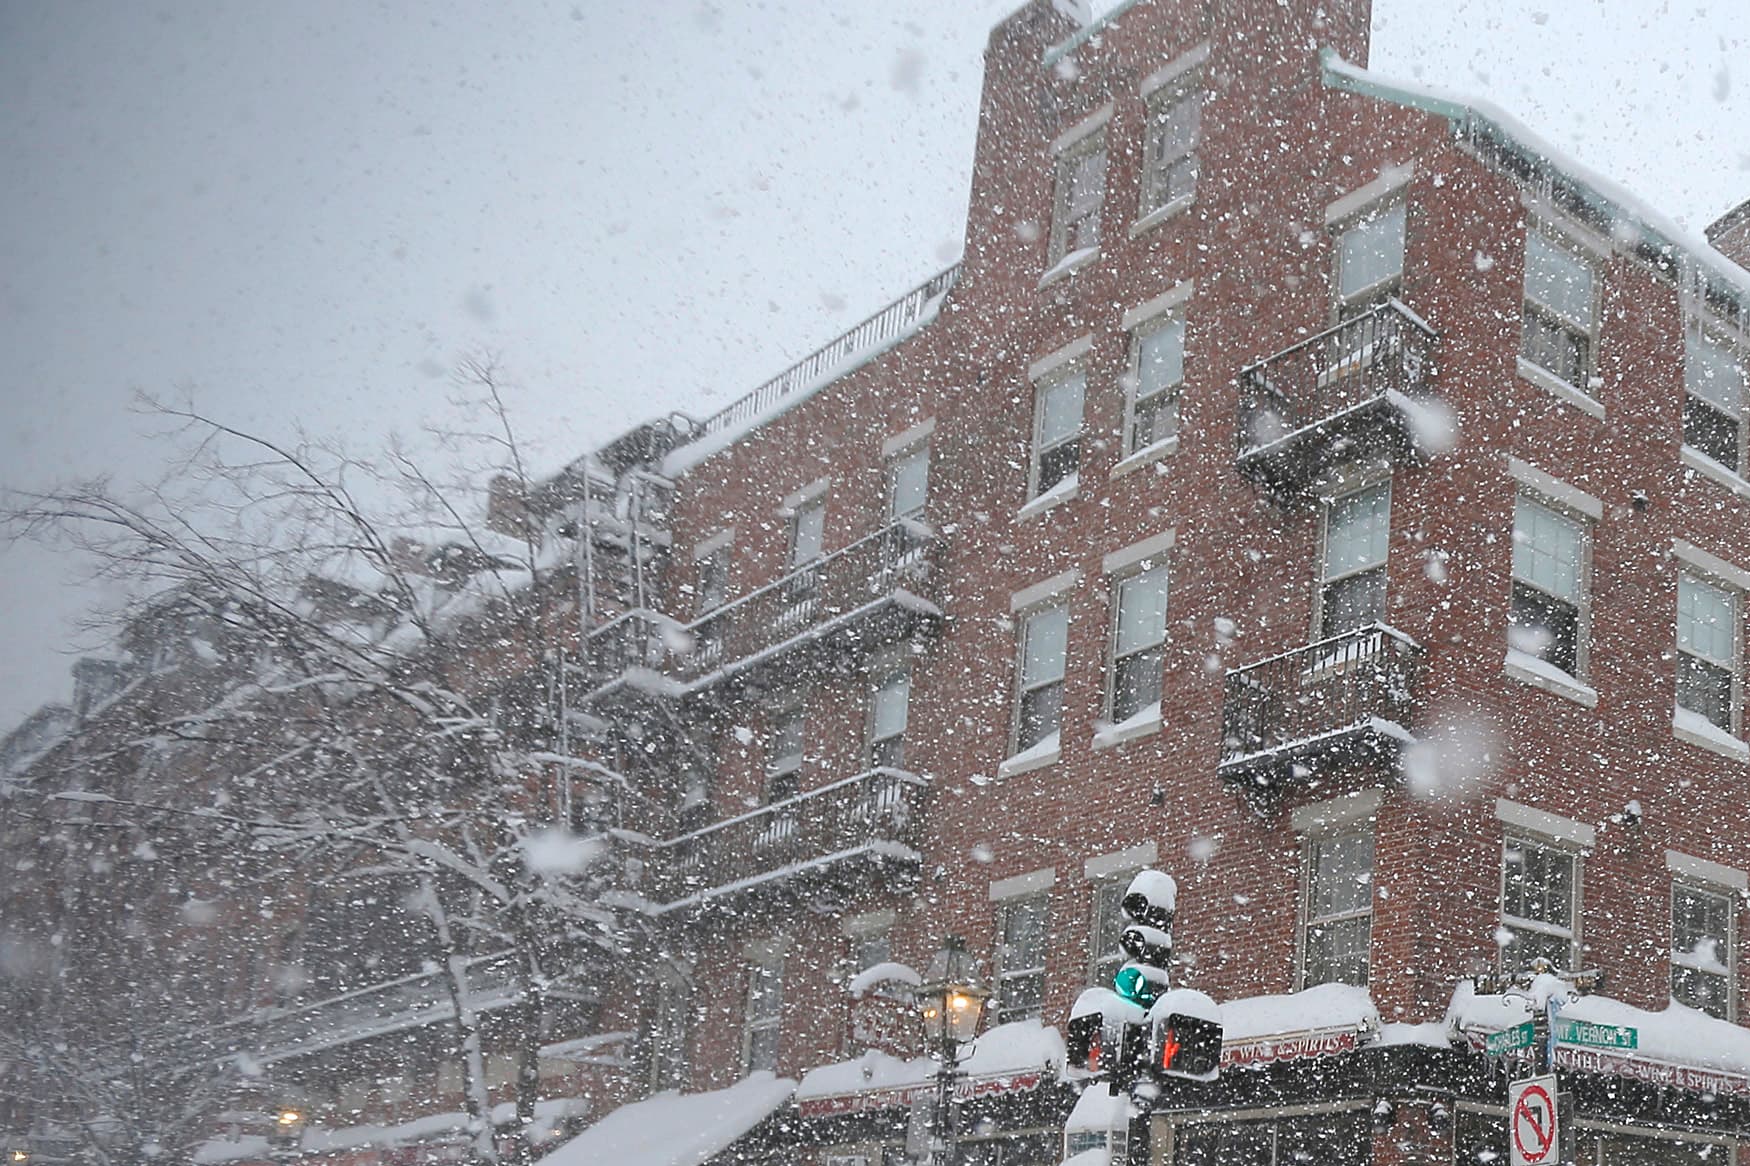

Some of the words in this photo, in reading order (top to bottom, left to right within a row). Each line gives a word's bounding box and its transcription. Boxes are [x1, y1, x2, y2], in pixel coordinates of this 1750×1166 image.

[1290, 1034, 1340, 1055] SPIRITS
[1576, 1026, 1617, 1045] VERNON
[1687, 1072, 1734, 1093] SPIRITS
